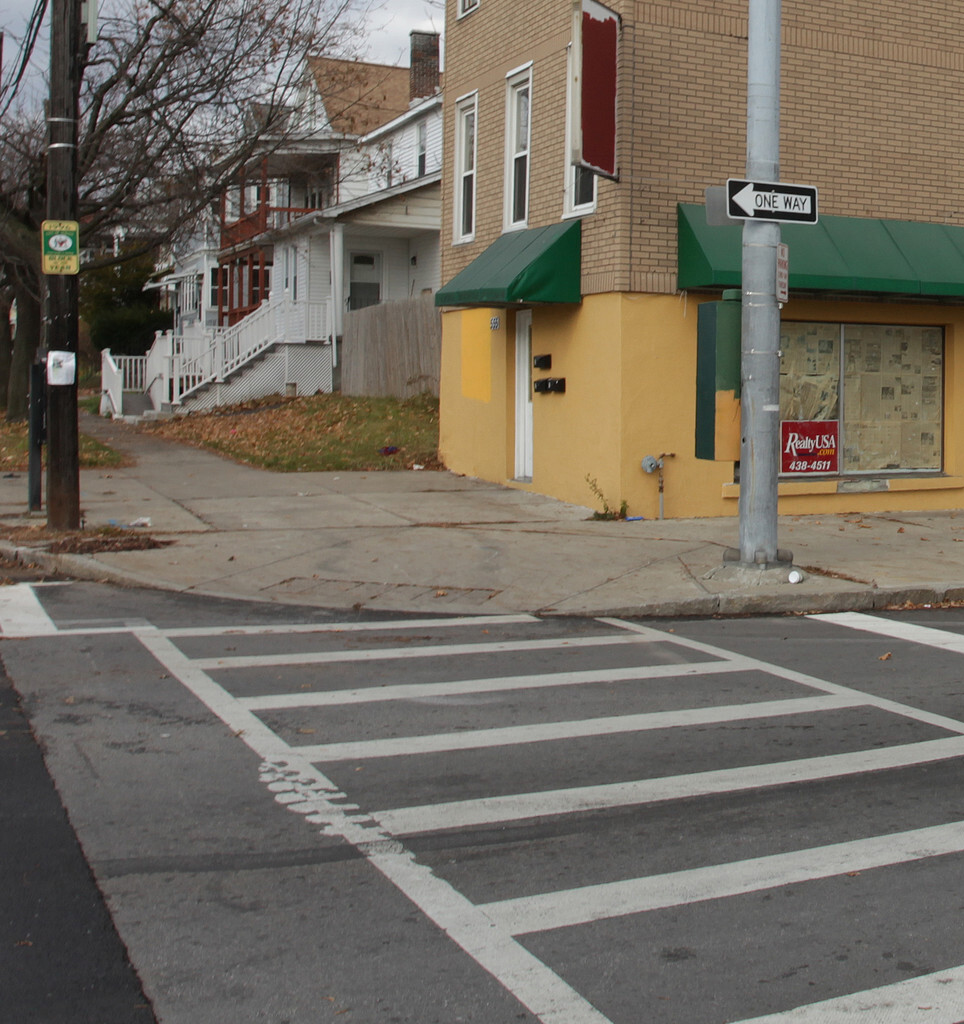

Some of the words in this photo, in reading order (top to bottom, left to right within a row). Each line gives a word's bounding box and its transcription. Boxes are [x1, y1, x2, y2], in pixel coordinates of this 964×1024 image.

[755, 193, 779, 209] ONE
[783, 195, 808, 211] WAY
[784, 432, 836, 456] RealtyUSA
[789, 460, 831, 471] 438-4511
